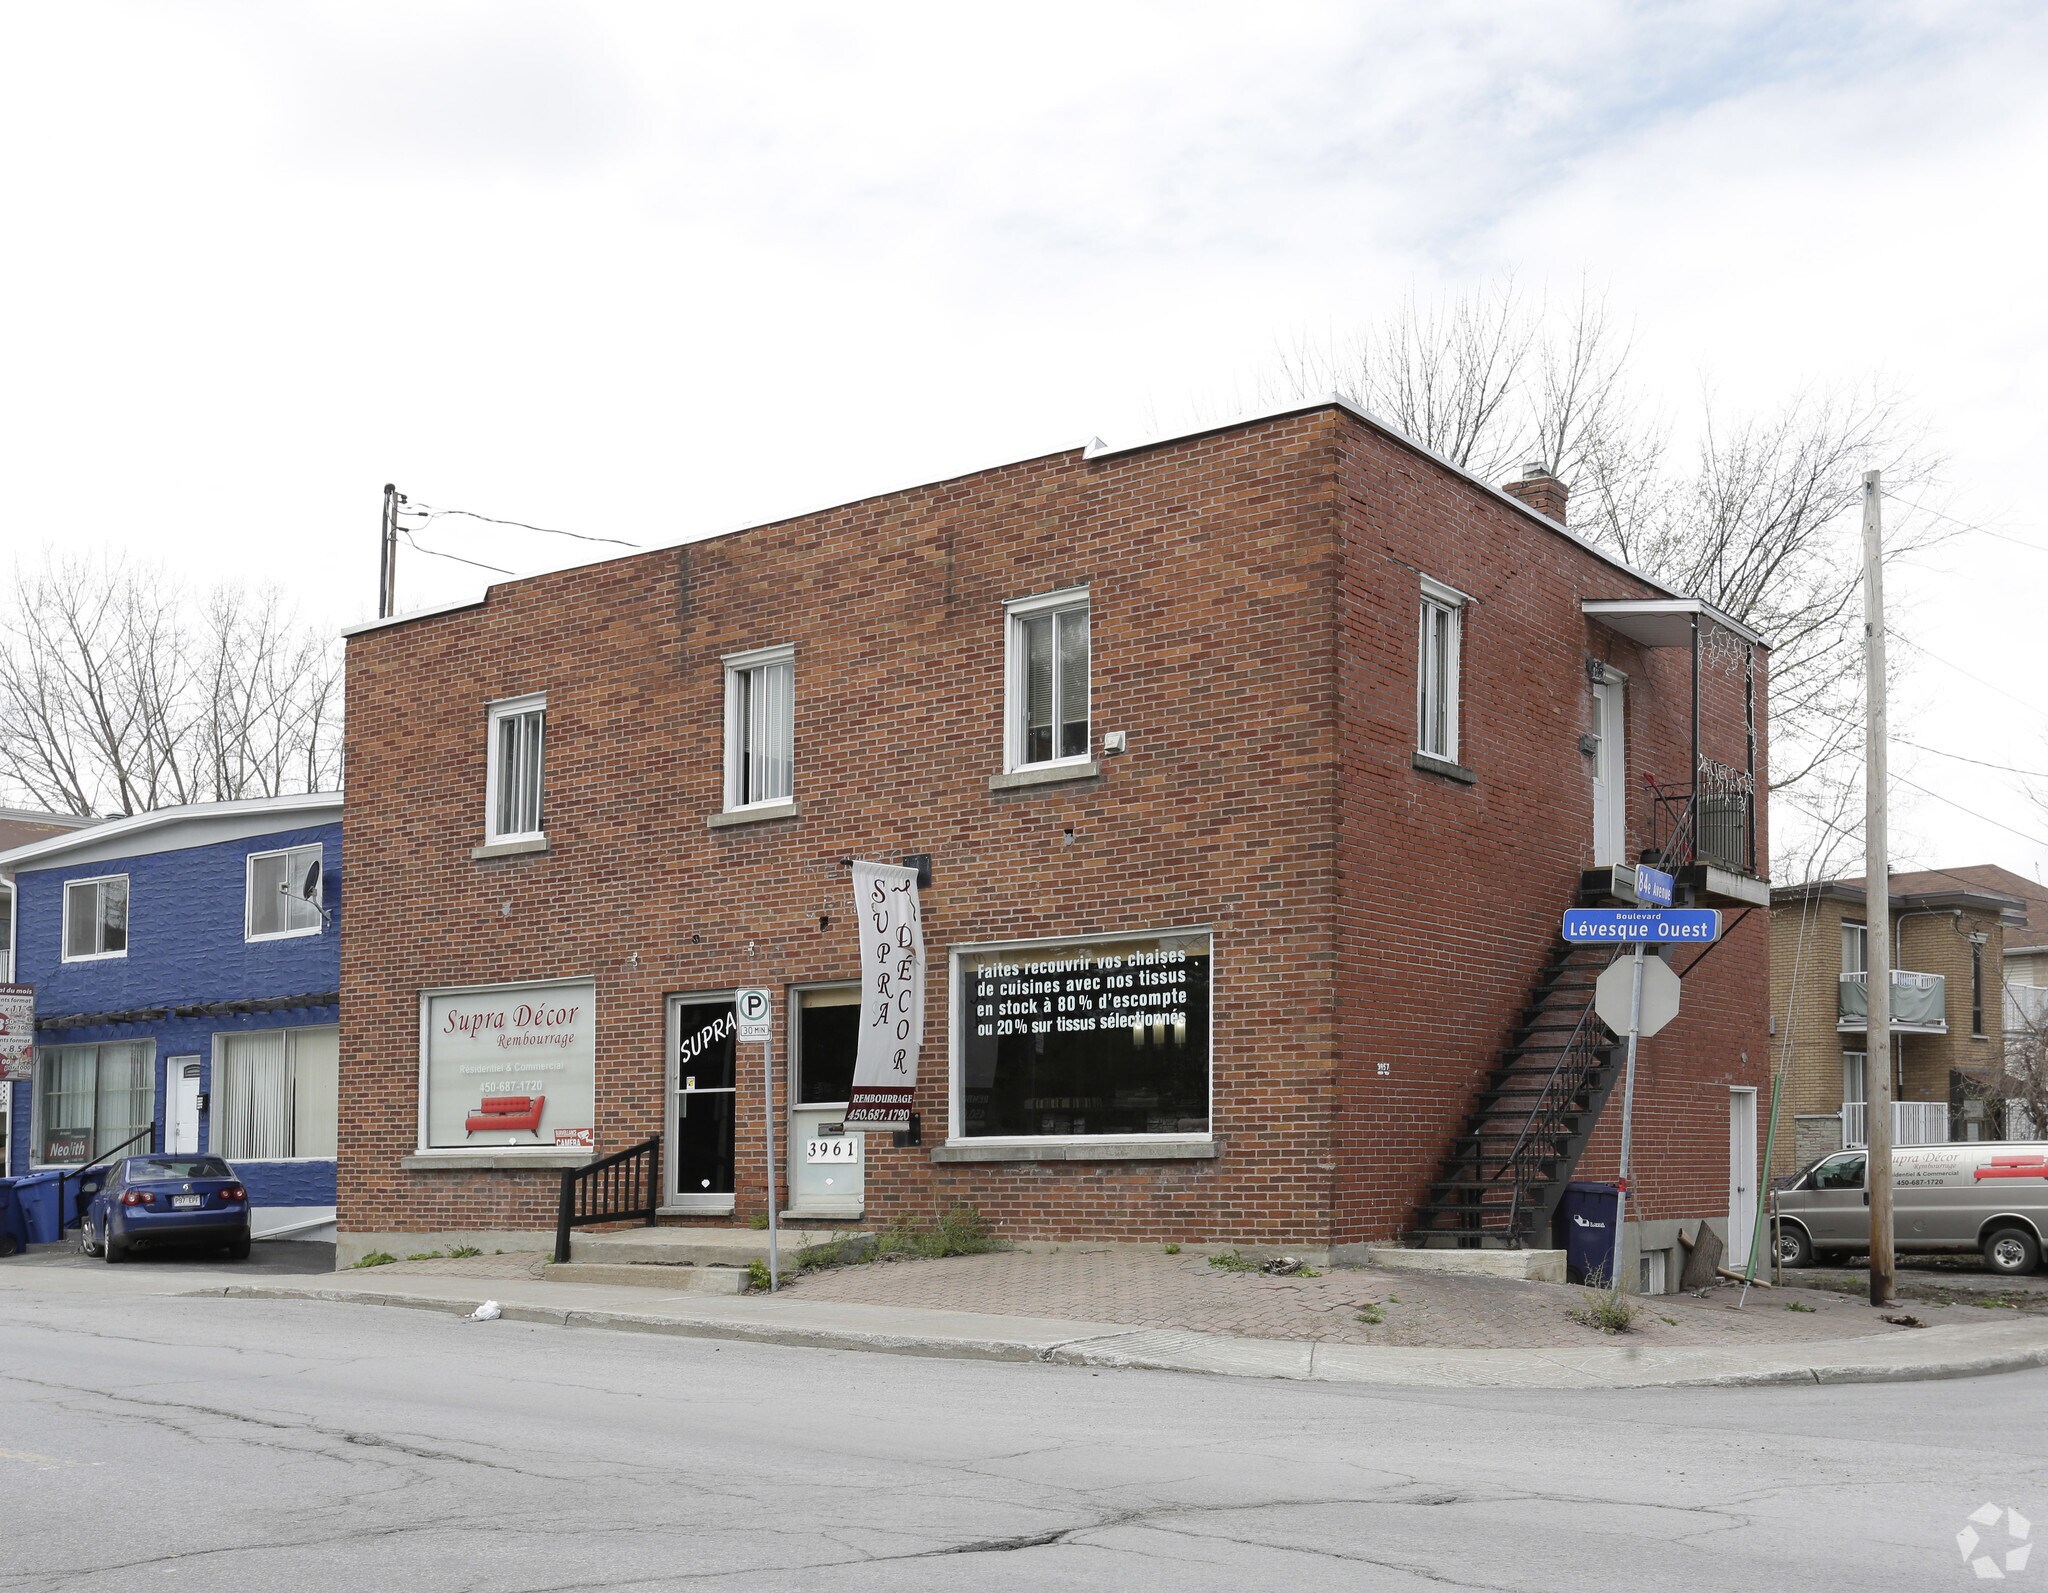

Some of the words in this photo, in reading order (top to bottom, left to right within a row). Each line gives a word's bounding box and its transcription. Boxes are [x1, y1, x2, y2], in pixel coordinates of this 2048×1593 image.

[1638, 871, 1651, 895] 84e
[1652, 882, 1671, 901] Avenue
[1570, 921, 1649, 940] Lévesque
[1658, 922, 1708, 937] Ouest
[872, 879, 894, 1027] SUPRA
[977, 960, 1019, 979] Faites
[1025, 955, 1091, 975] recouvrir
[1097, 954, 1122, 970] vos
[1127, 948, 1186, 968] chaises
[977, 982, 994, 997] de
[1000, 976, 1060, 996] cuisines
[1066, 976, 1101, 992] avec
[1107, 974, 1133, 989] nos
[1139, 969, 1186, 986] tissus
[748, 996, 762, 1016] P
[977, 1003, 993, 1017] en
[999, 998, 1038, 1016] stock
[1043, 997, 1052, 1013] à
[443, 1009, 505, 1038] Supra
[512, 1003, 580, 1027] Décor
[977, 1023, 993, 1037] ou
[1031, 1020, 1053, 1034] sur
[1056, 1016, 1096, 1033] tissus
[1100, 1008, 1187, 1030] sélectionnés
[496, 1030, 575, 1049] Rembourrage
[680, 1011, 737, 1063] SUPRA
[743, 1026, 753, 1035] 30
[459, 1063, 504, 1074] Résidentiel
[505, 1062, 512, 1071] &
[514, 1061, 564, 1071] Commercial
[479, 1080, 543, 1093] 450-687-1720
[852, 1094, 913, 1103] REMBOURRAGE
[847, 1108, 910, 1120] 450.687.1720
[50, 1141, 85, 1157] Neolith
[808, 1141, 853, 1157] 3961
[1892, 1155, 1920, 1166] upra
[1923, 1152, 1960, 1163] Décor
